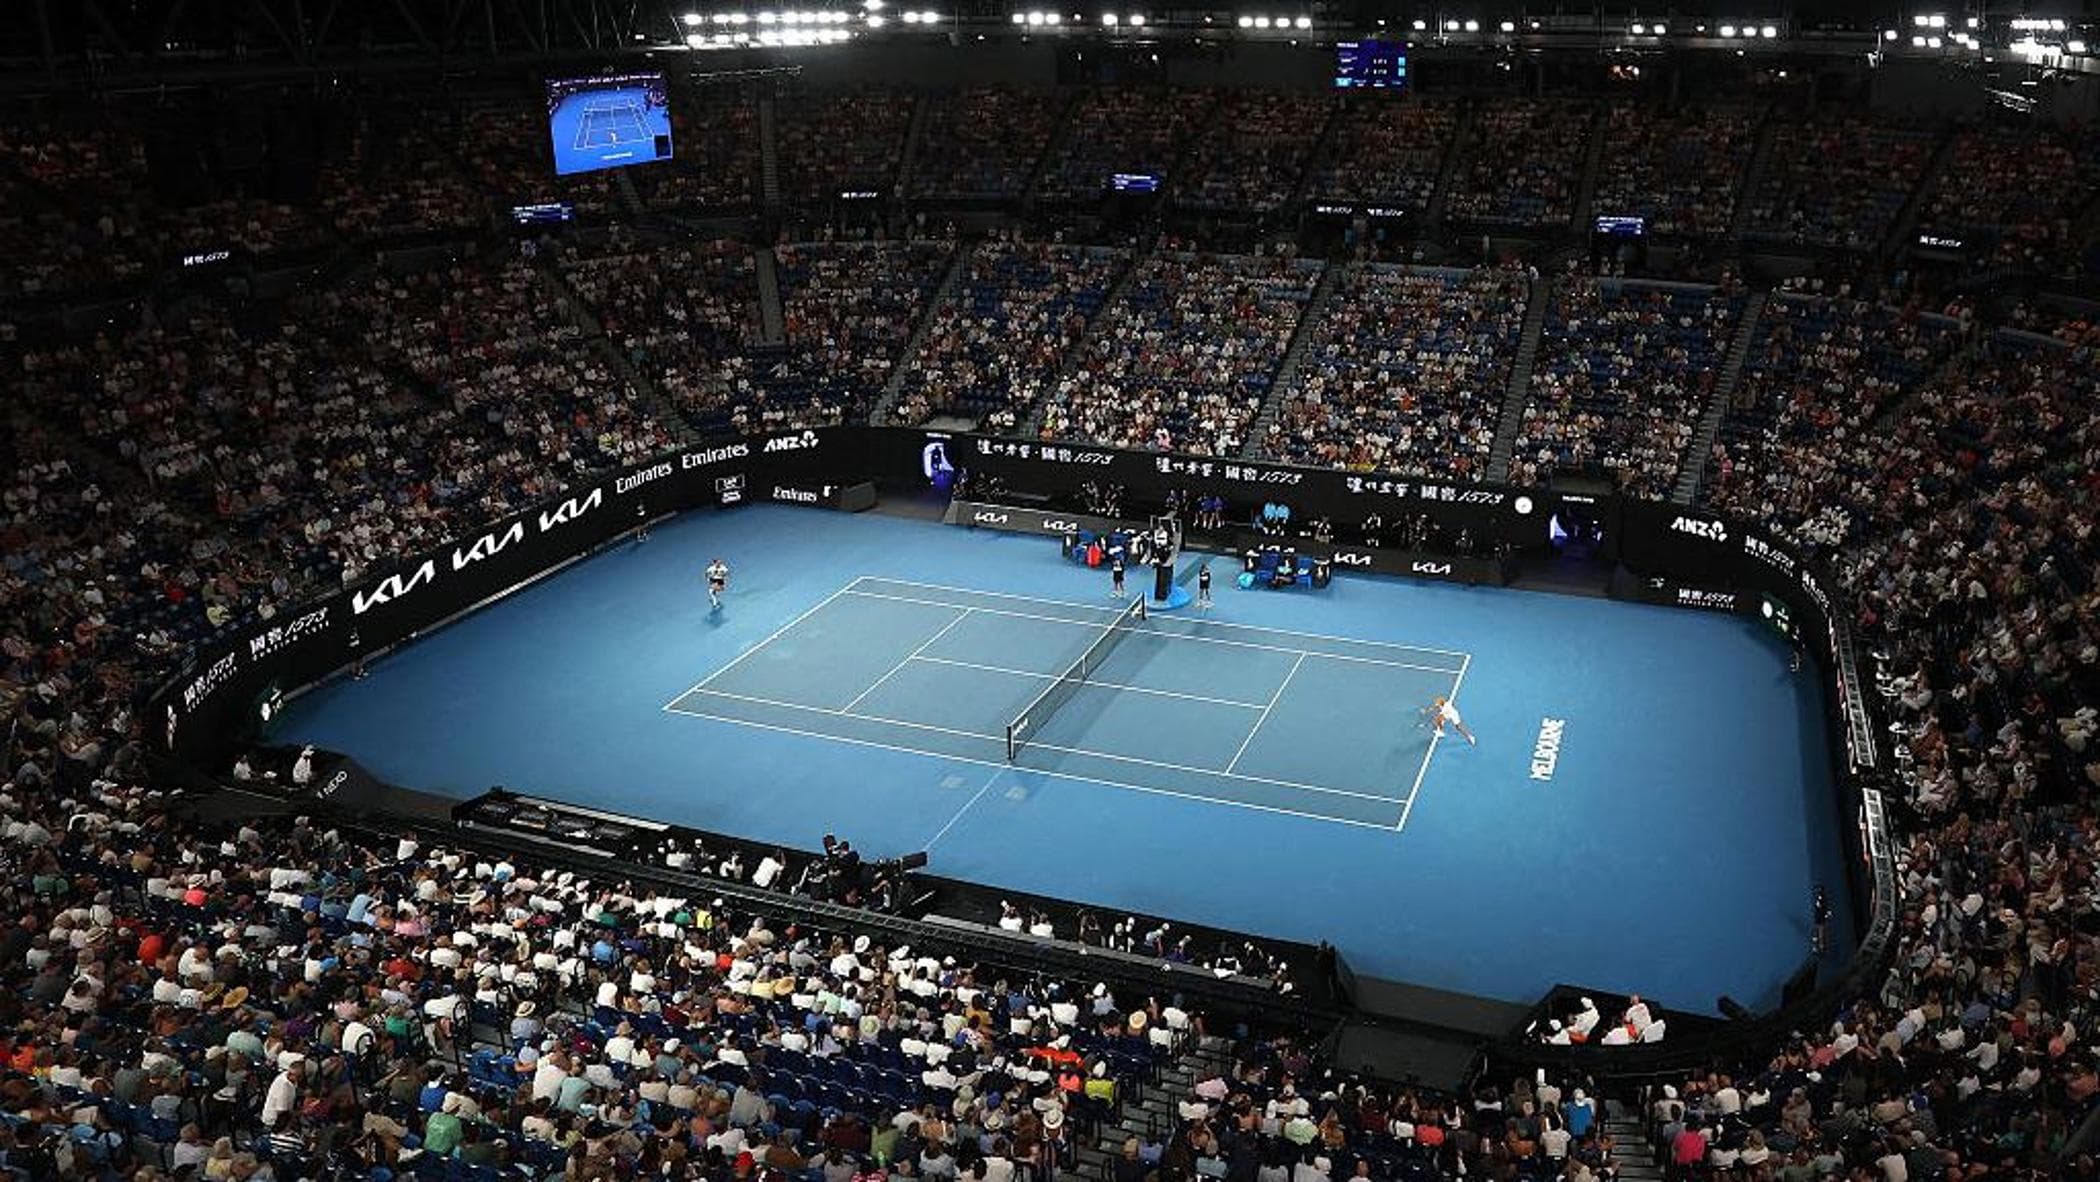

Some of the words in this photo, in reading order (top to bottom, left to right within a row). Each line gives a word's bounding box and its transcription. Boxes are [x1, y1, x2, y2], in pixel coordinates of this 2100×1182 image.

[682, 443, 749, 470] Emirates
[763, 437, 800, 453] ANZ
[616, 461, 673, 494] Emirates
[1670, 516, 1709, 537] ANZ
[1529, 717, 1566, 781] MELBOURNE
